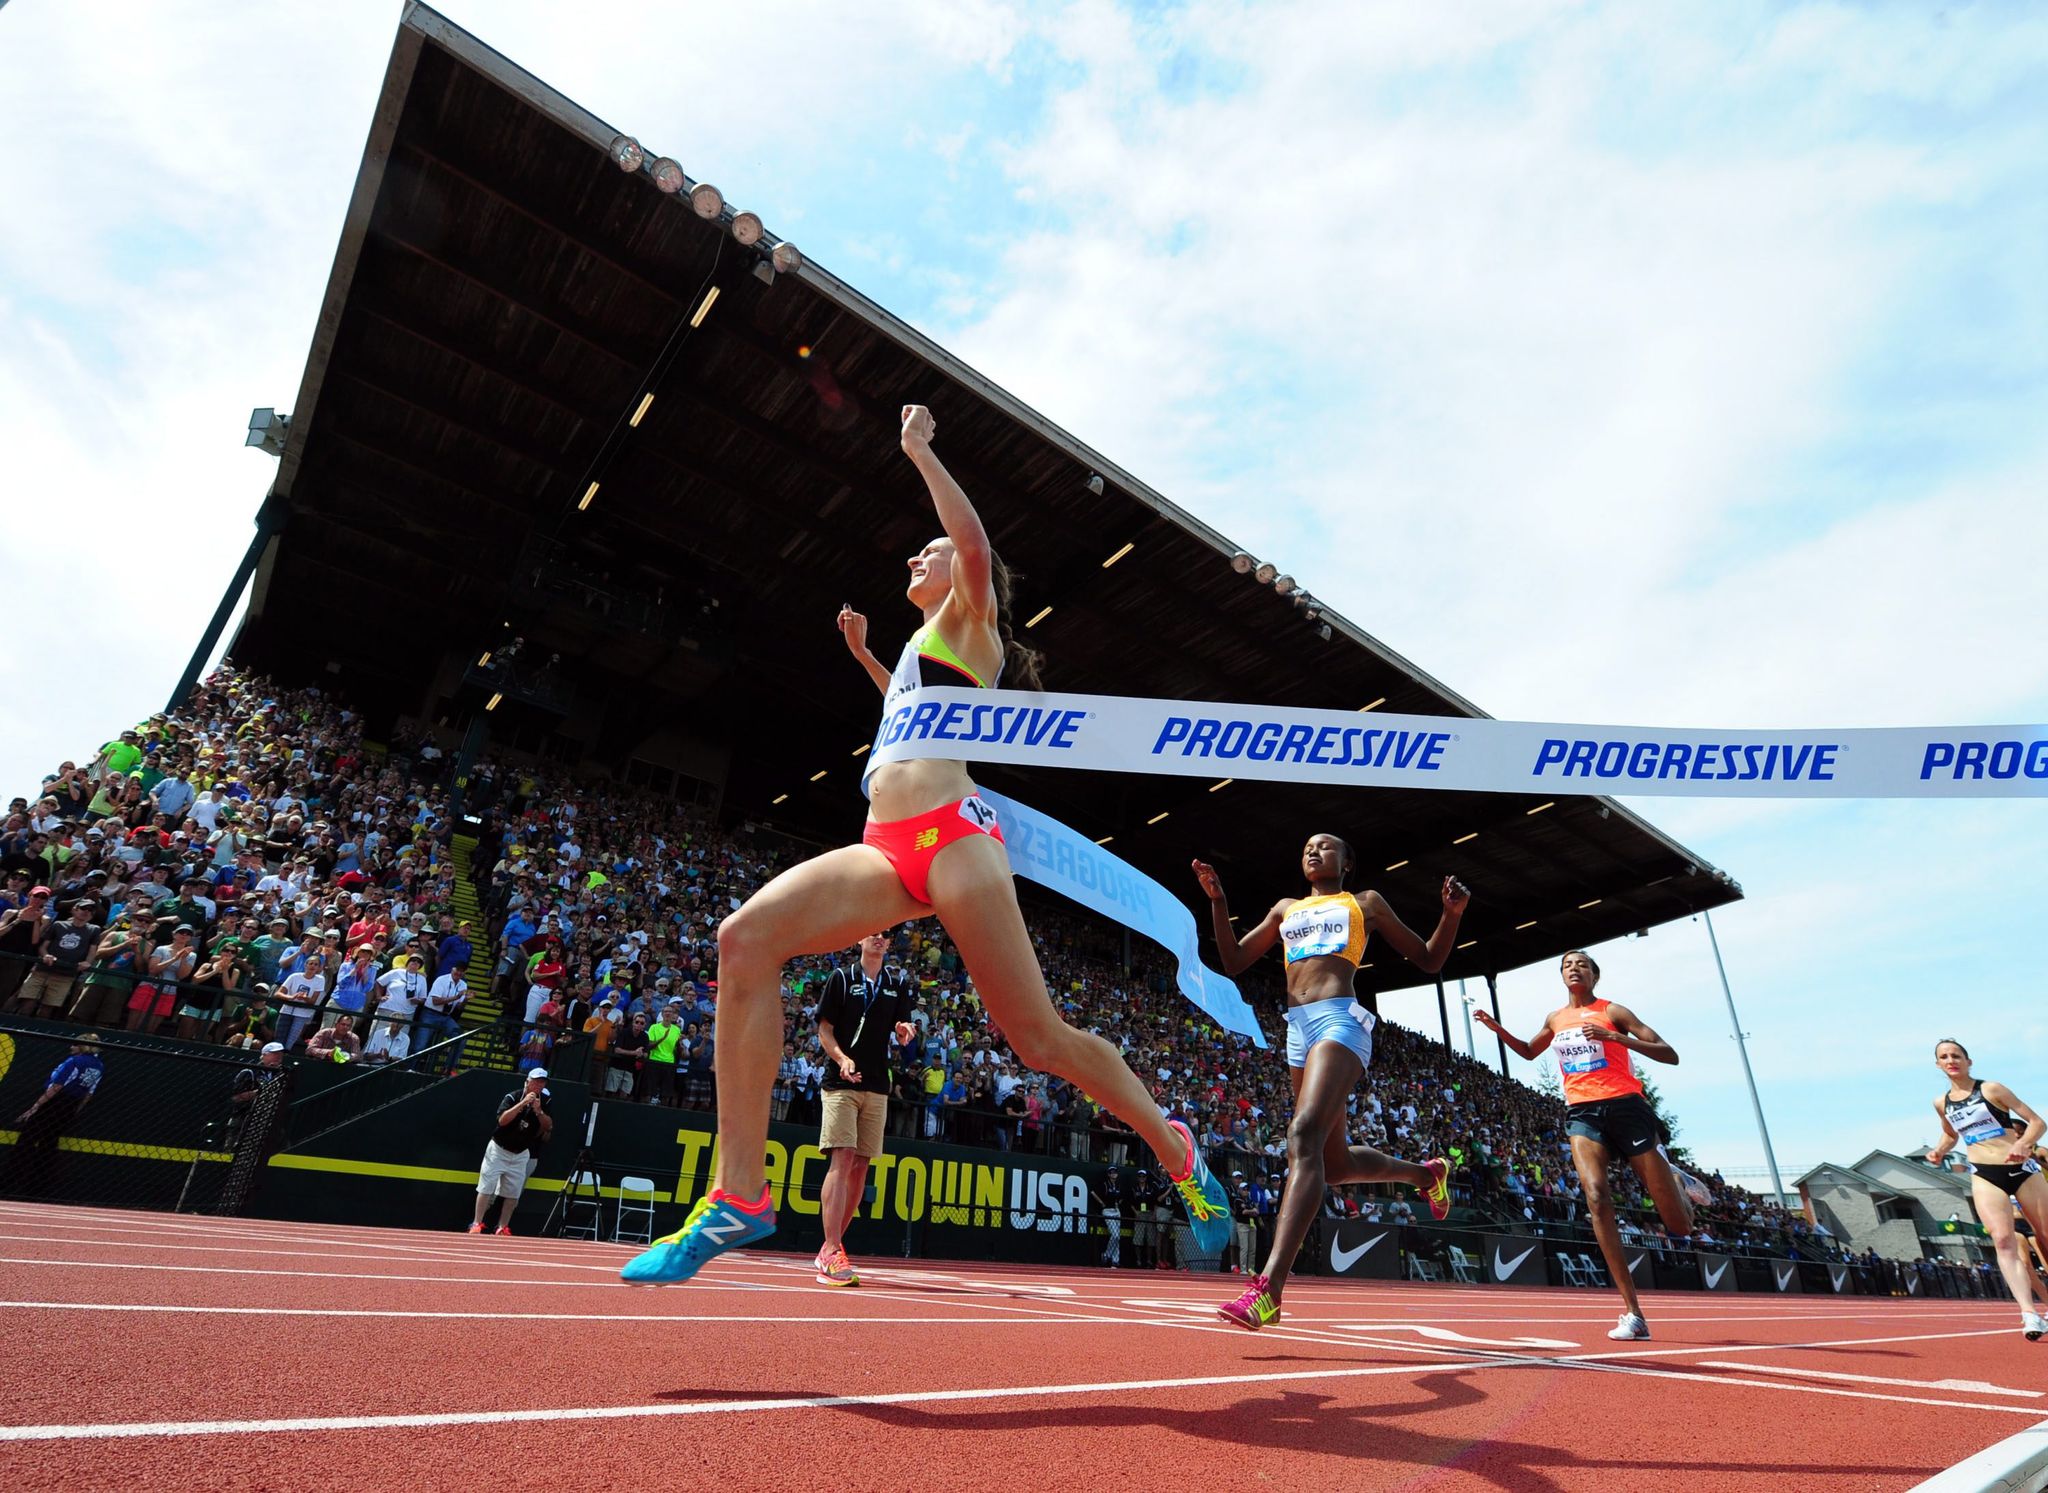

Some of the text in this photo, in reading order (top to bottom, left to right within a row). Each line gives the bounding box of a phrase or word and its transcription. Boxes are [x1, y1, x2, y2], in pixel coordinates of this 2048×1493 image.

[1152, 717, 1450, 770] PROGRESSIVE
[1532, 739, 1838, 781] PROGRESSIVE
[1920, 740, 2048, 780] PROG
[967, 798, 994, 826] 14
[1285, 923, 1343, 940] CHERONO
[1560, 1045, 1597, 1057] HASSAN
[1577, 1061, 1602, 1072] Eugene
[675, 1129, 1088, 1233] TACTOWN USA
